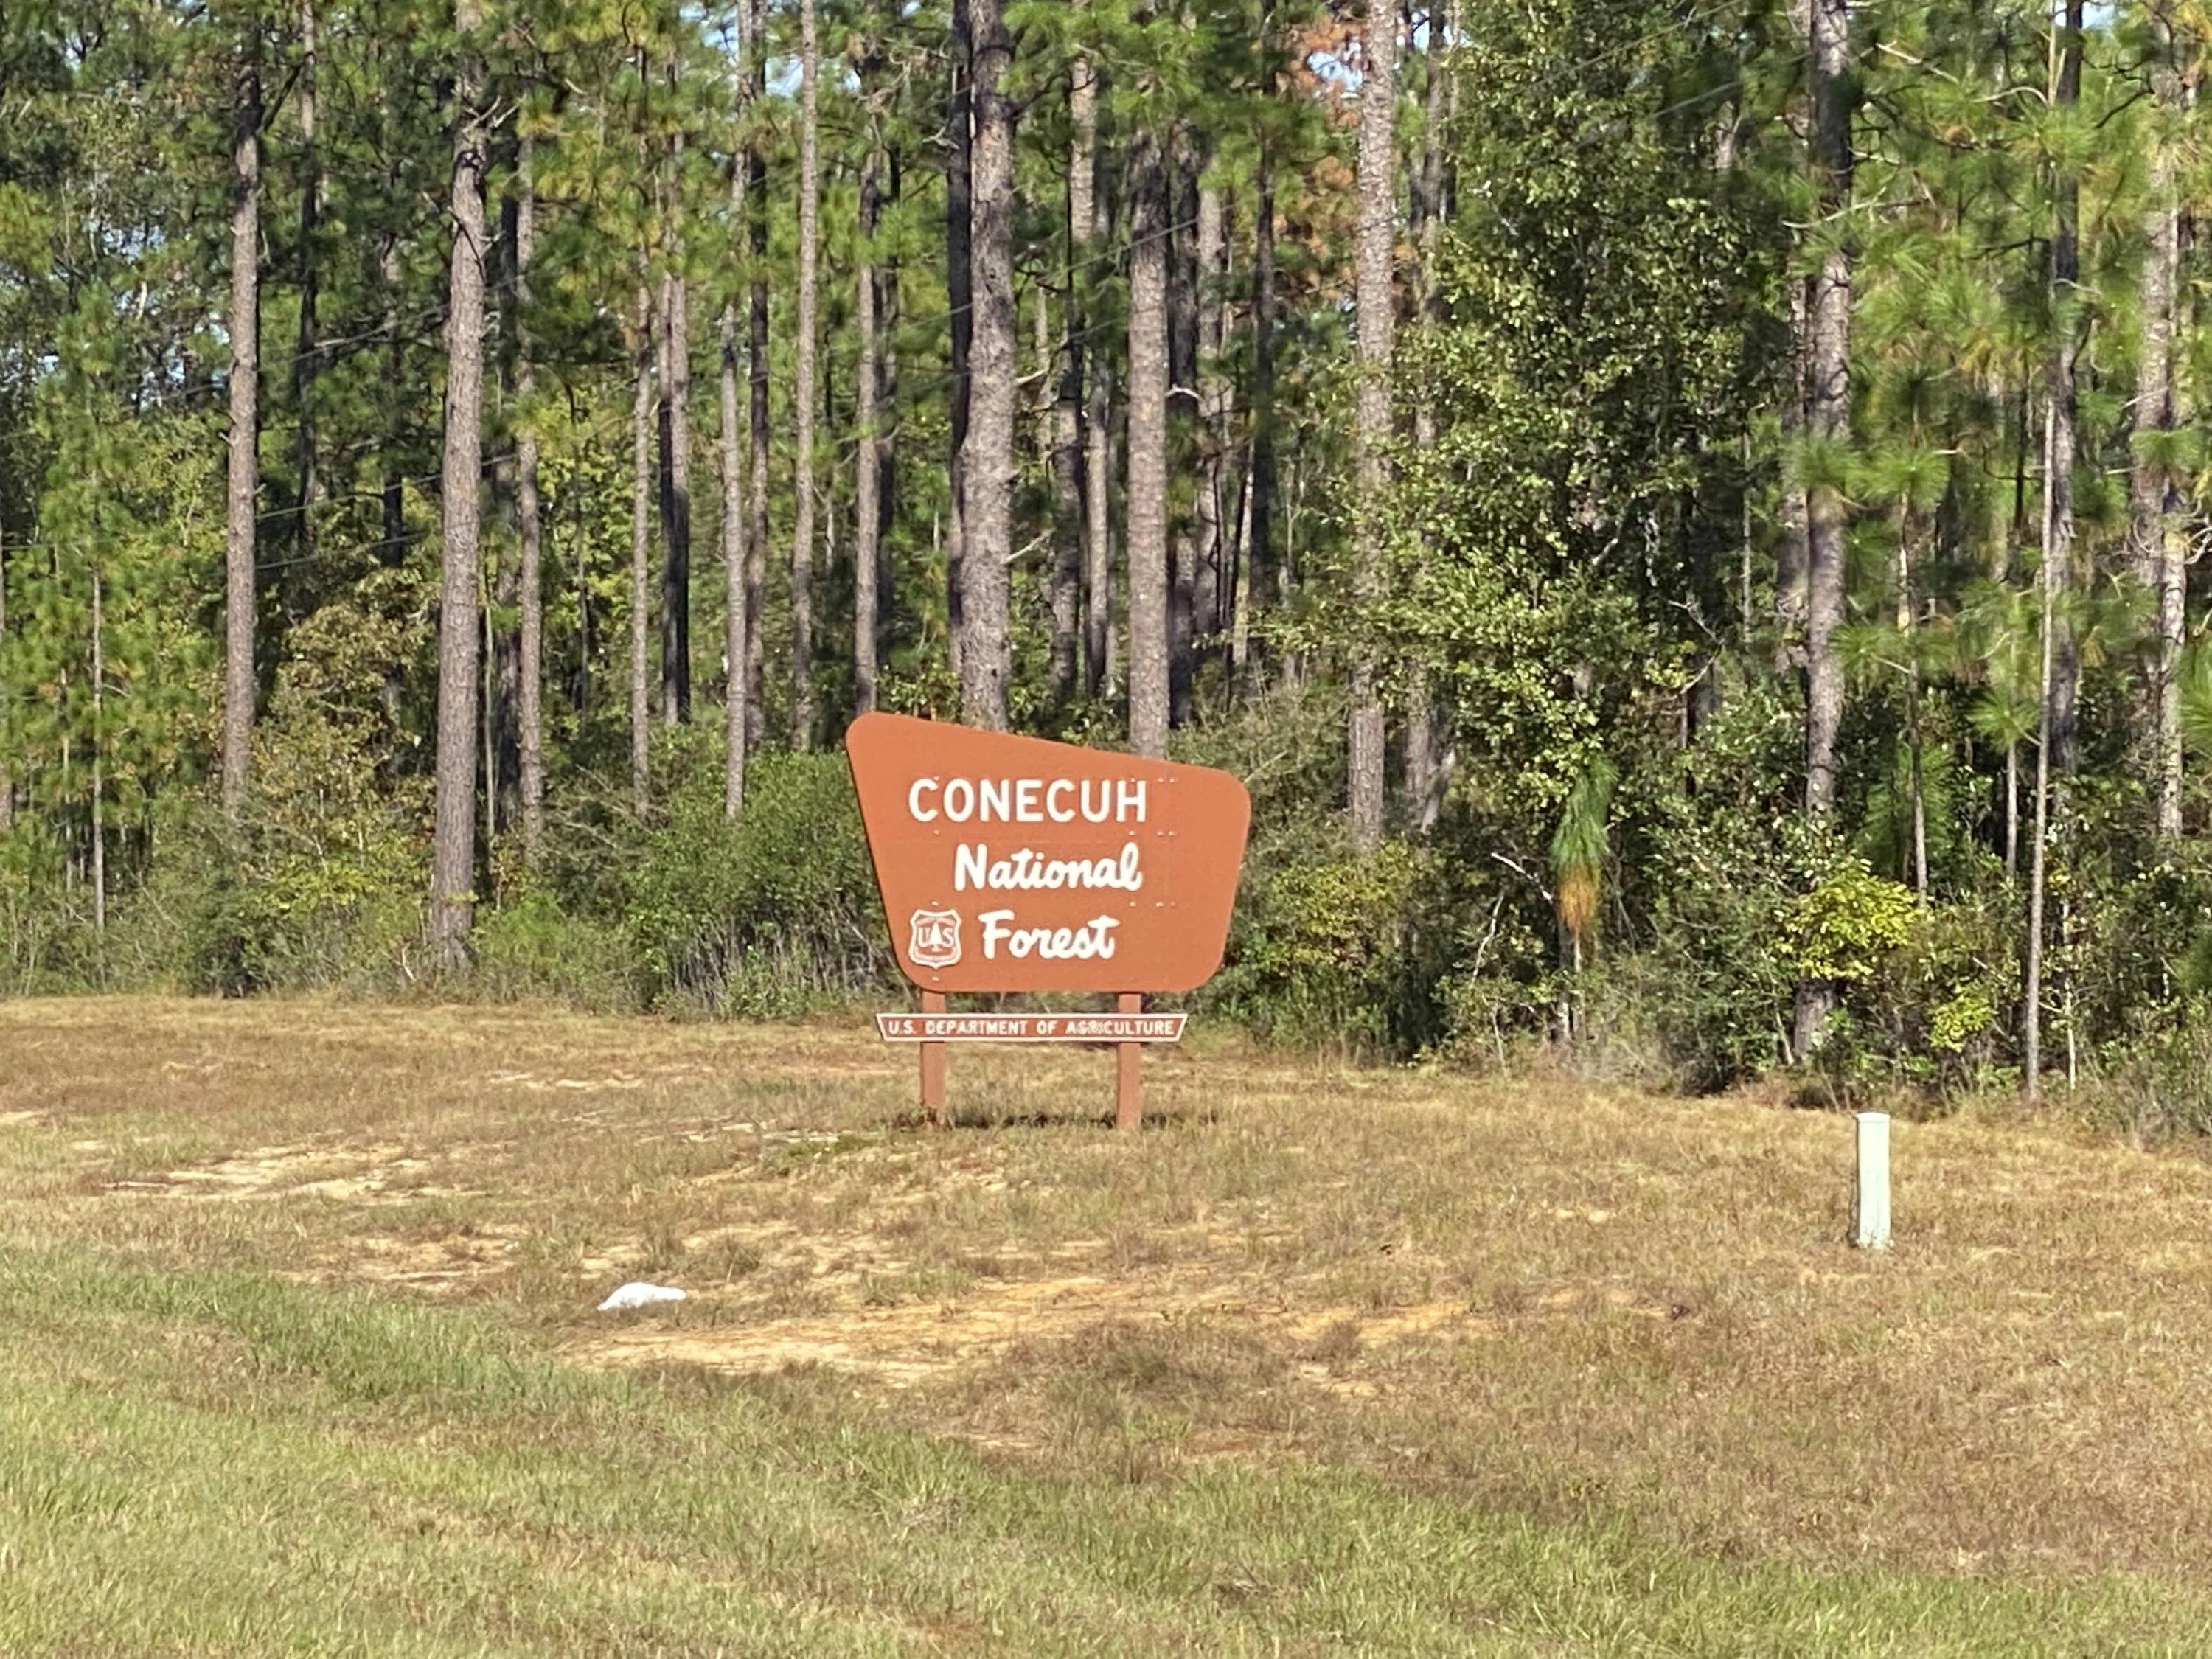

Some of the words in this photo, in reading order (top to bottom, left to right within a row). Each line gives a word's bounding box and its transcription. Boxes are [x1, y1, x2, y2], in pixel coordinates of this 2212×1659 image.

[908, 777, 1147, 823] CONECUH
[953, 842, 1143, 892] National
[978, 909, 1121, 960] Forest
[888, 1020, 917, 1035] U.S.
[925, 1020, 1028, 1035] DEPARTMENT
[1037, 1020, 1057, 1035] OF
[1065, 1020, 1175, 1035] AGRICULTURE
